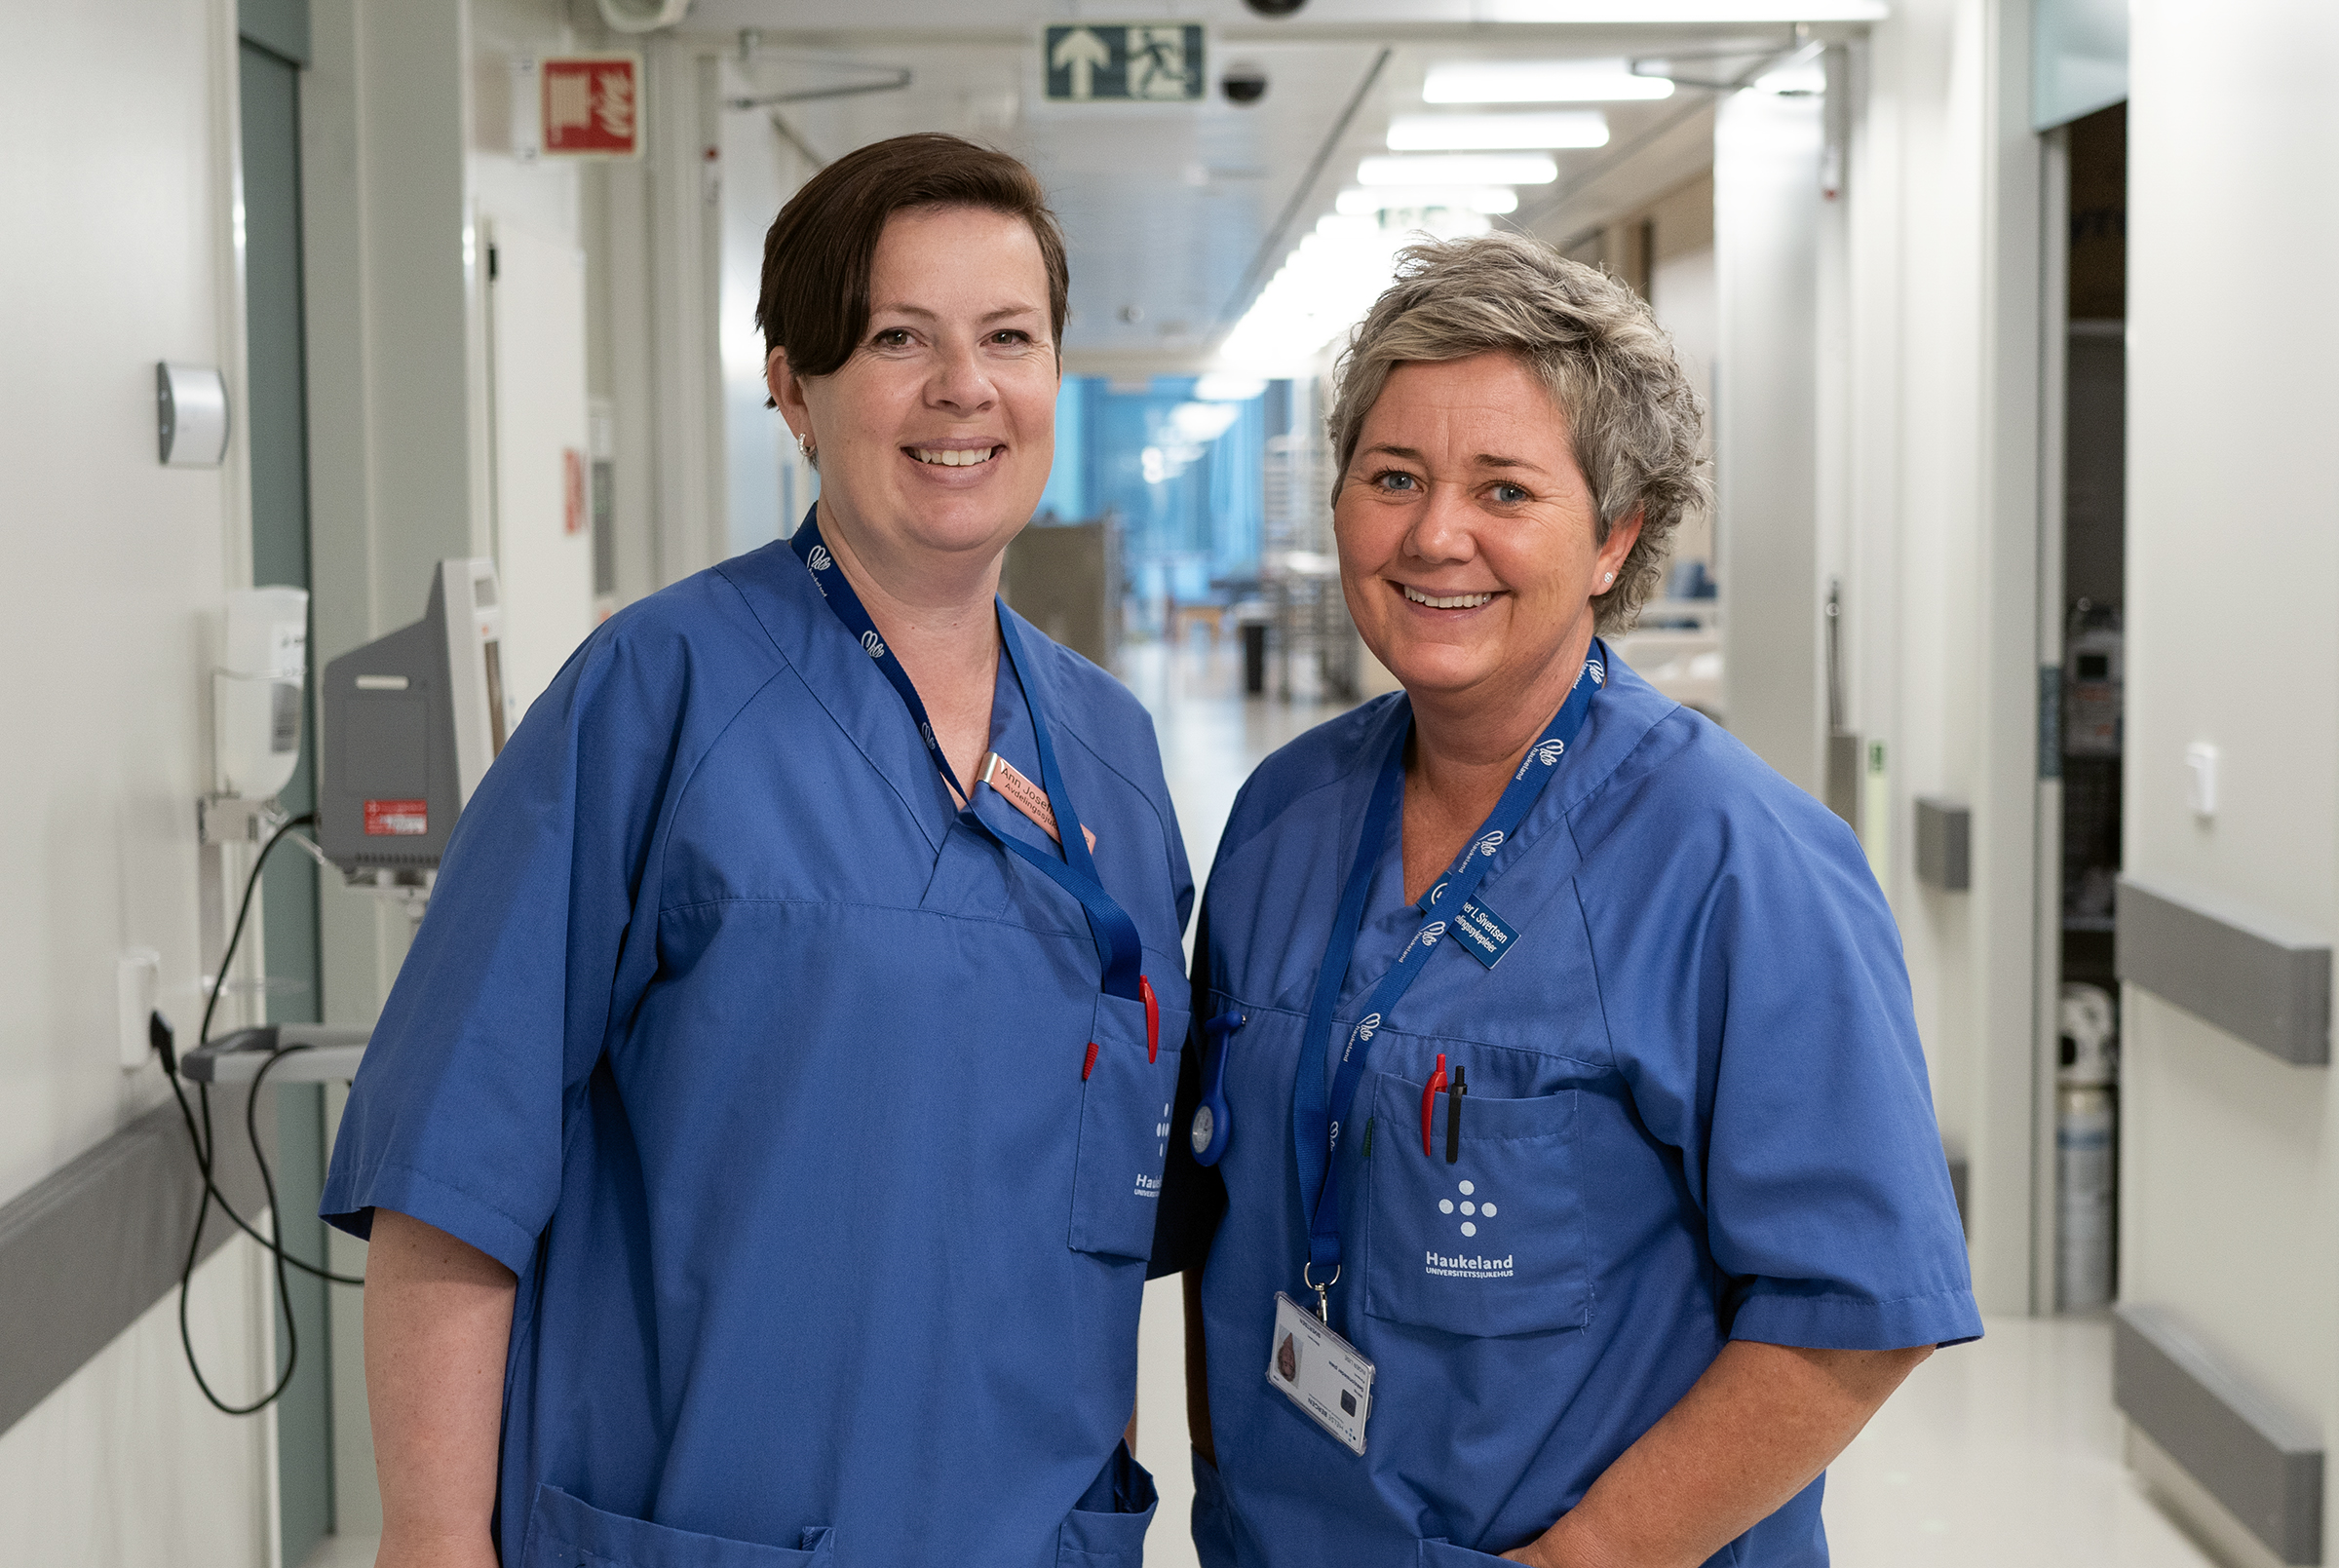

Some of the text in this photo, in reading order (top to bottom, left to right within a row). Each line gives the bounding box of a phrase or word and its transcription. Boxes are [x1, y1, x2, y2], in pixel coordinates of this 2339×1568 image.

[1001, 768, 1021, 788] Ann
[1515, 746, 1540, 781] haukeland
[1458, 840, 1481, 874] haukeland
[1454, 914, 1497, 953] elingssykepleier
[1476, 912, 1508, 944] Sivertsen
[1398, 931, 1423, 964] haukeland
[1343, 1025, 1361, 1062] haukeland
[1425, 1266, 1515, 1280] UNIVERSITETSSJUKEHUS
[1426, 1250, 1514, 1270] Haukeland
